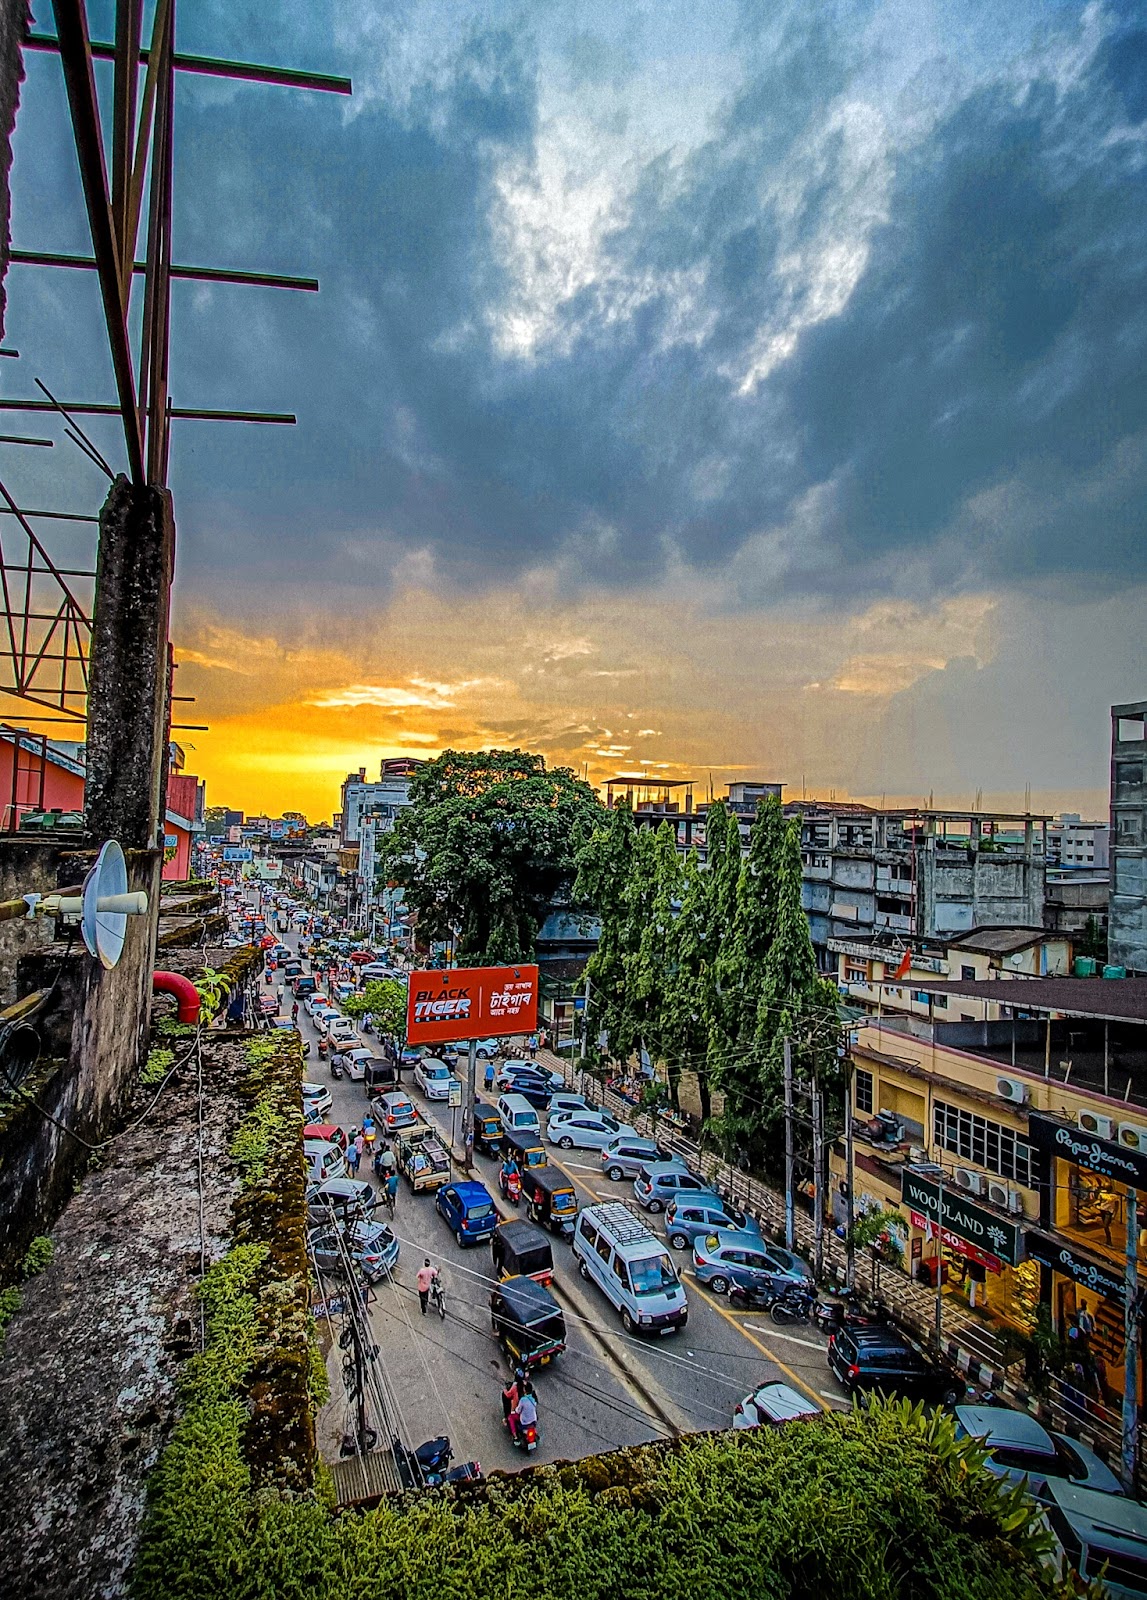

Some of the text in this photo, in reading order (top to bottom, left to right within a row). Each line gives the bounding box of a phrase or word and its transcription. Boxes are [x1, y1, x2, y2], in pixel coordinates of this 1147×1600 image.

[416, 988, 470, 1001] BLACK
[414, 999, 471, 1016] TIGER
[1055, 1128, 1137, 1171] Pepe Jeans
[1078, 1158, 1112, 1176] LONDON
[908, 1184, 984, 1236] WOODLAND
[1059, 1249, 1090, 1275] Pepe
